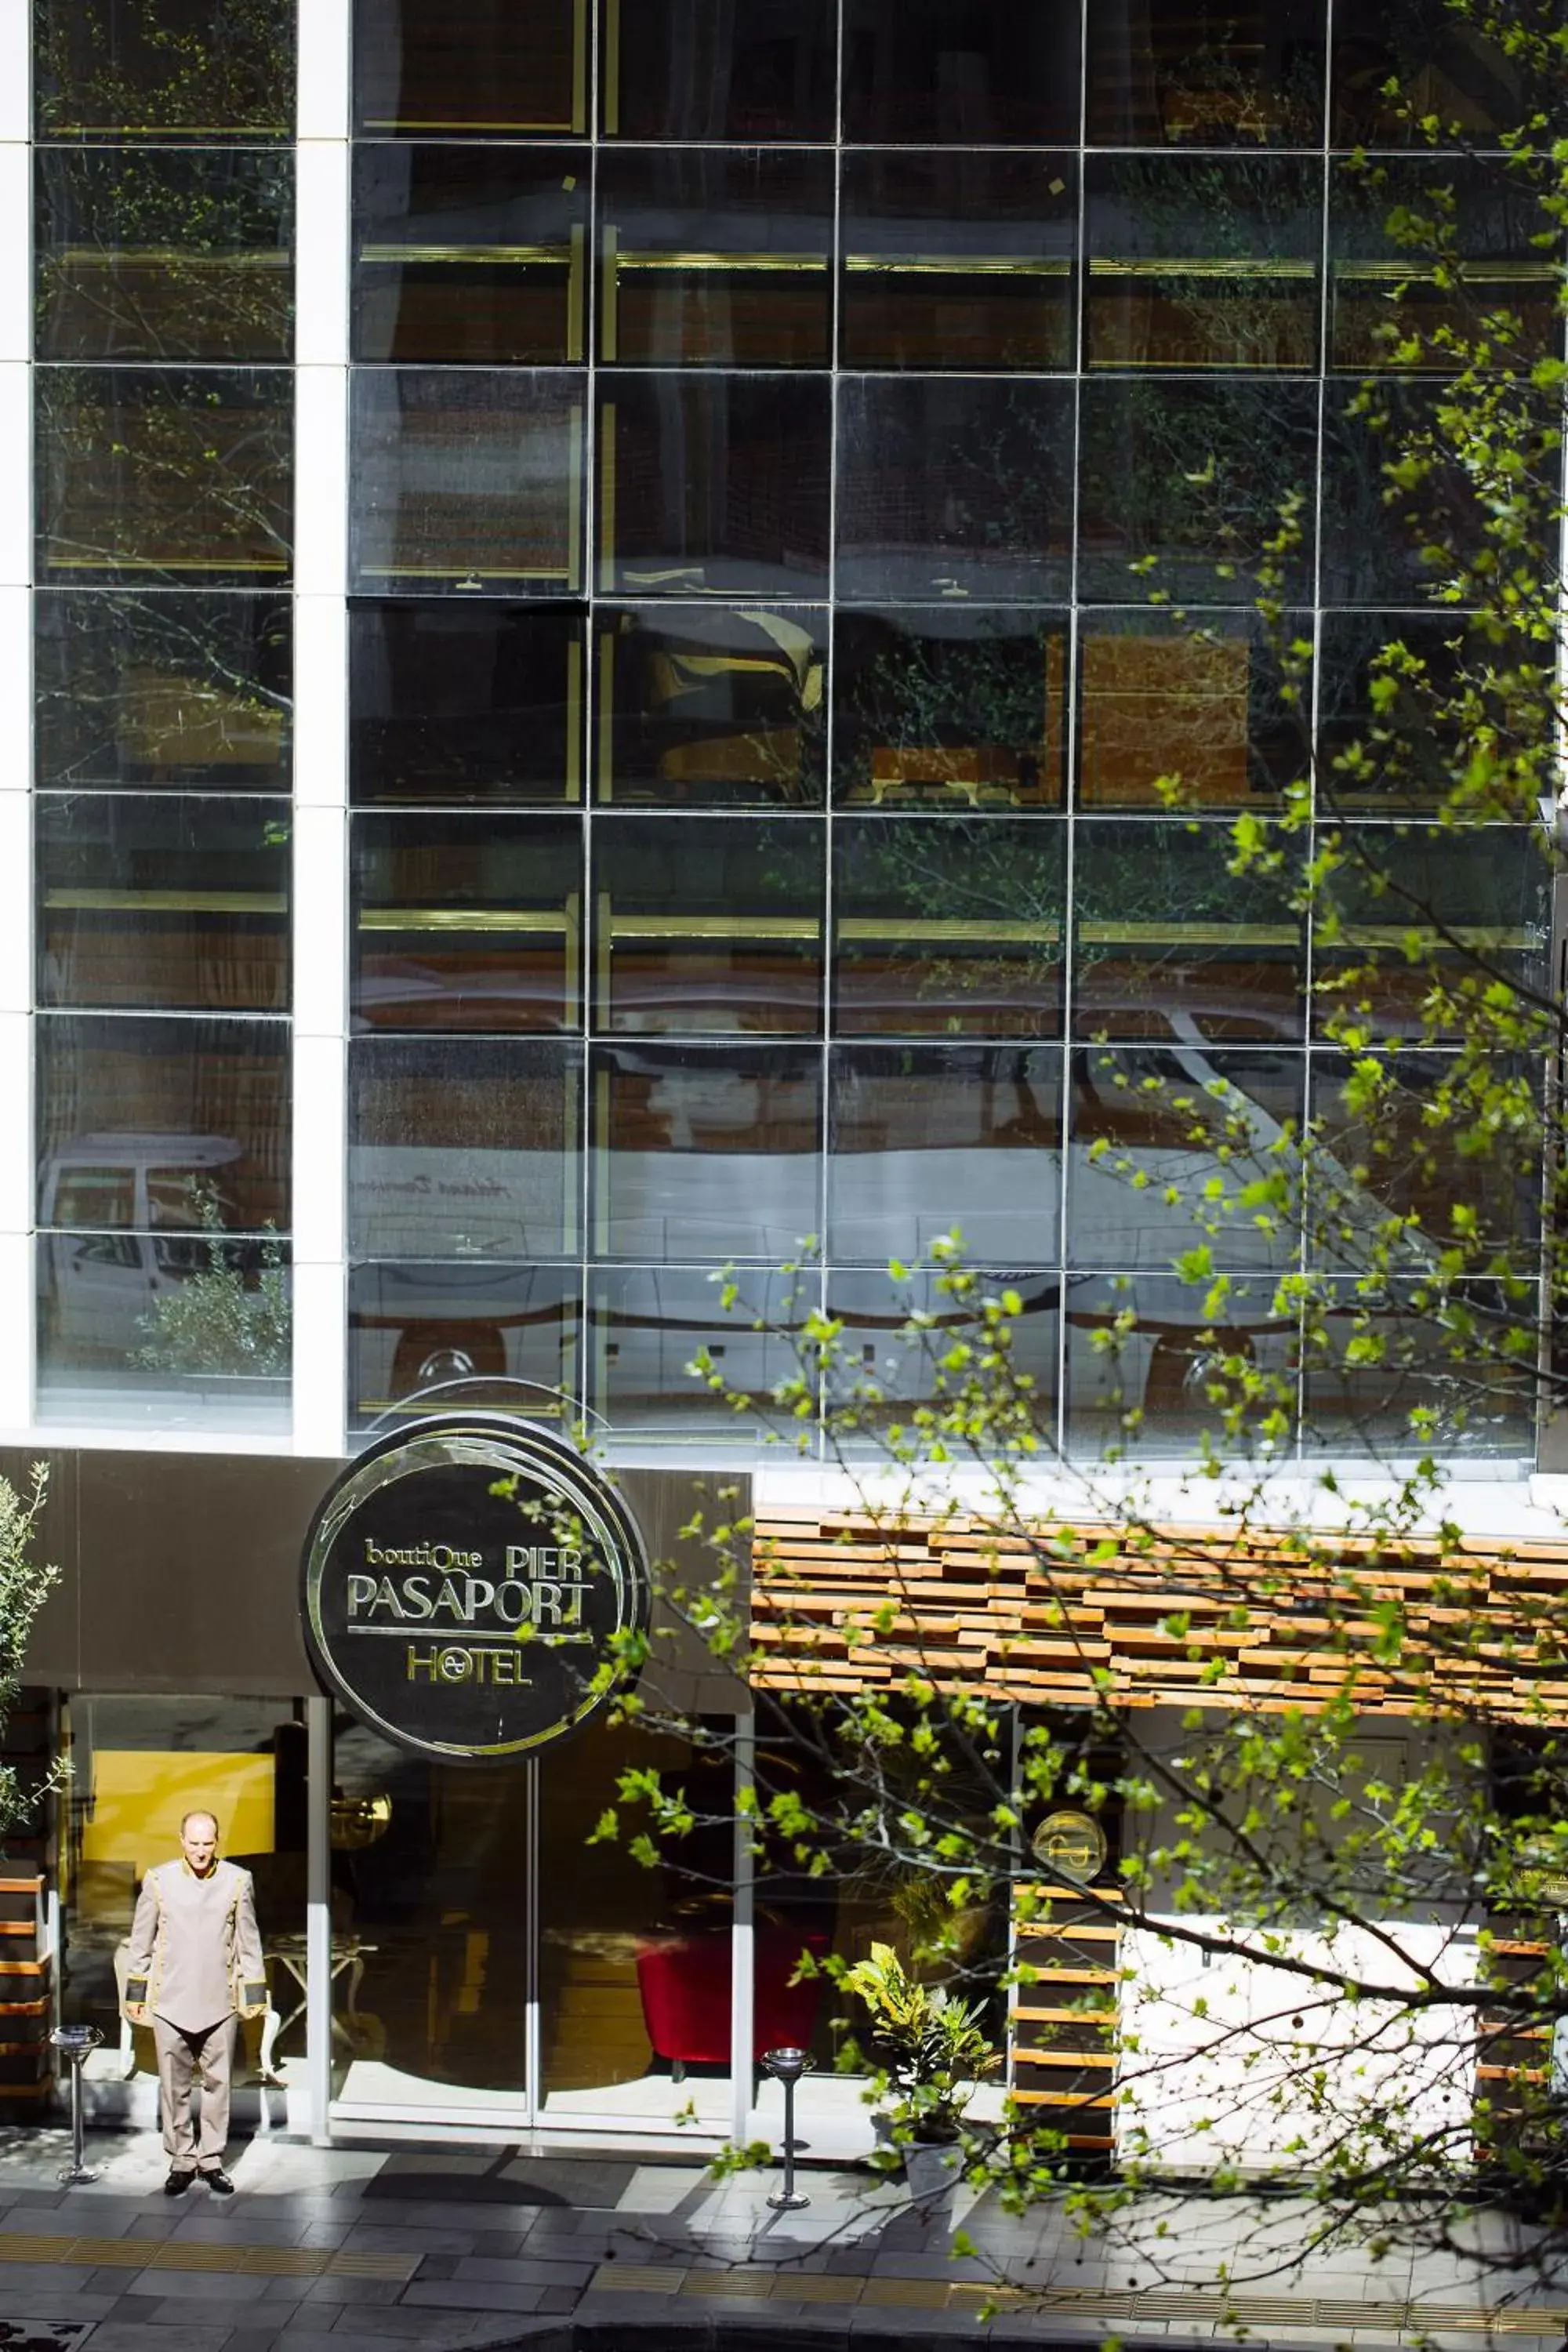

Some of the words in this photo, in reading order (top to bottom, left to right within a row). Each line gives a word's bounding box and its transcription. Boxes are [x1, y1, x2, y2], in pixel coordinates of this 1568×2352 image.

[506, 1545, 583, 1581] PIER
[347, 1574, 594, 1625] PASAPORT
[407, 1646, 532, 1686] HOTEL
